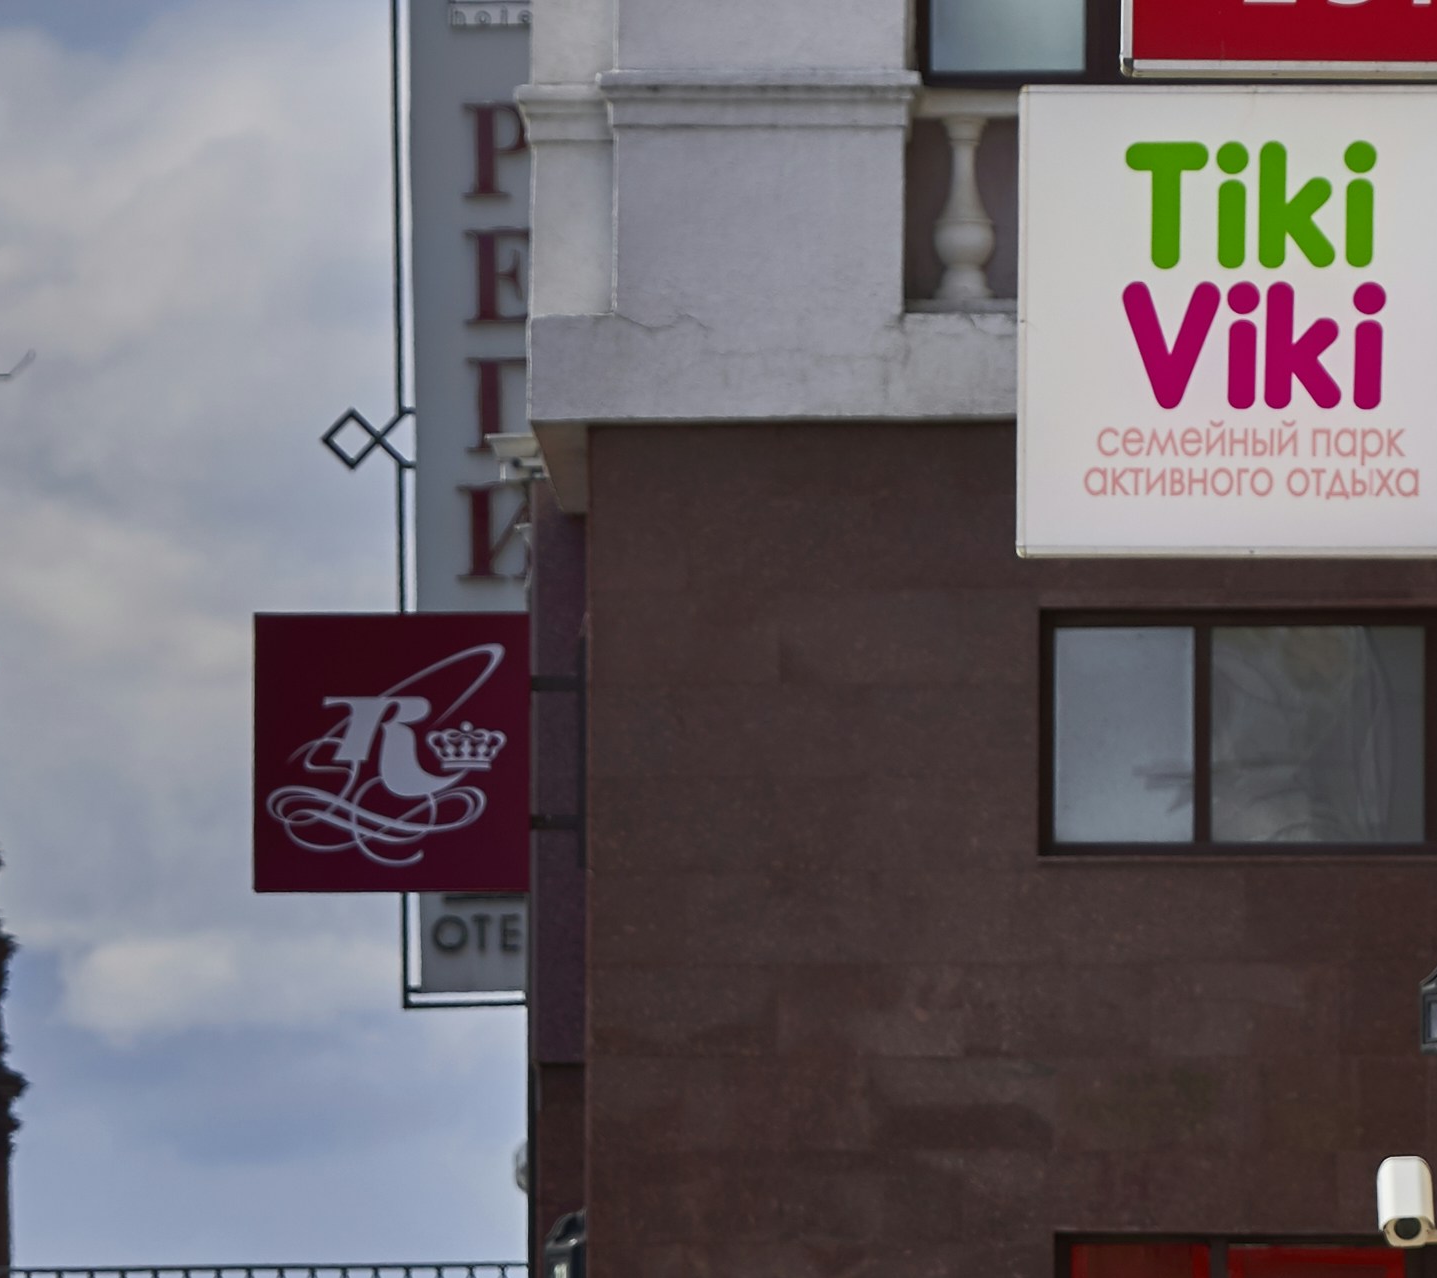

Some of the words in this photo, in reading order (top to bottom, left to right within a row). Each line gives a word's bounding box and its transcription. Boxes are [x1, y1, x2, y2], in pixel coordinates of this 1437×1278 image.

[1125, 140, 1378, 269] Tiki
[1122, 280, 1387, 410] Viki
[1083, 466, 1274, 498] активного
[1285, 466, 1421, 500] отдыха
[1096, 419, 1299, 458] семейный
[1310, 427, 1405, 466] парк
